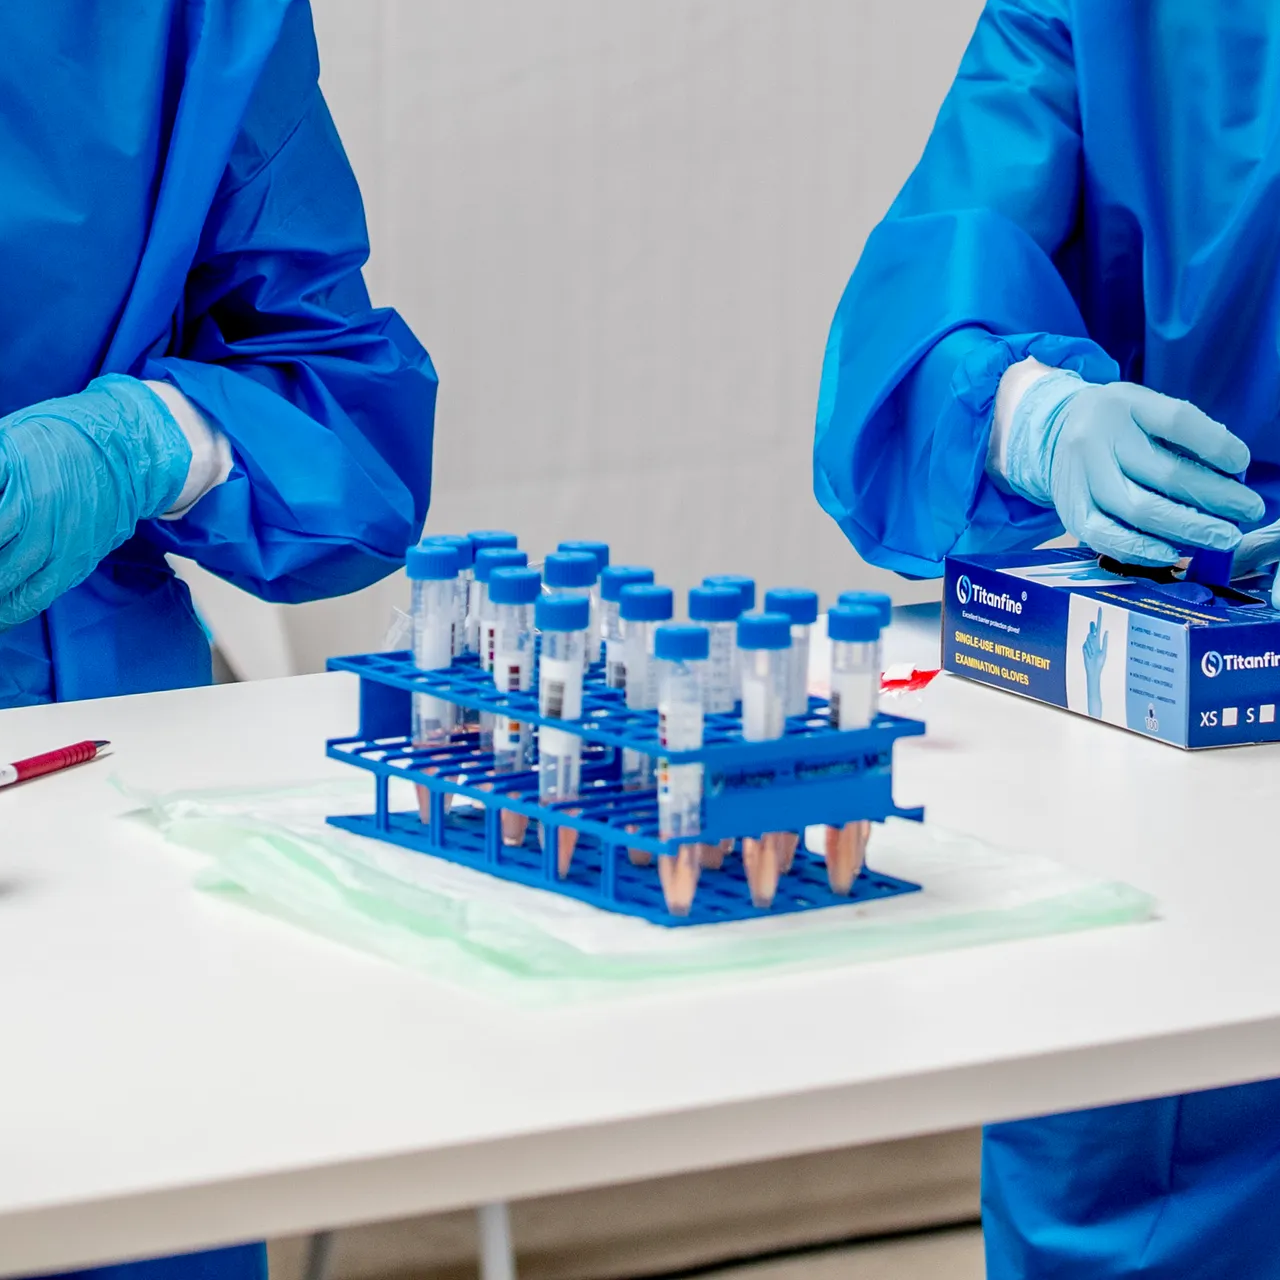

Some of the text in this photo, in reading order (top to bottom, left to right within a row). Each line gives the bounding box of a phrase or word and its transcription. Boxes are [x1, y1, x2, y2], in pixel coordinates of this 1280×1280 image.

[955, 630, 1051, 671] SINGLE-USE NITRILE PATIENT
[955, 652, 1029, 686] EXAMINATION GLOVES
[1200, 711, 1218, 728] XS
[1246, 707, 1255, 724] S
